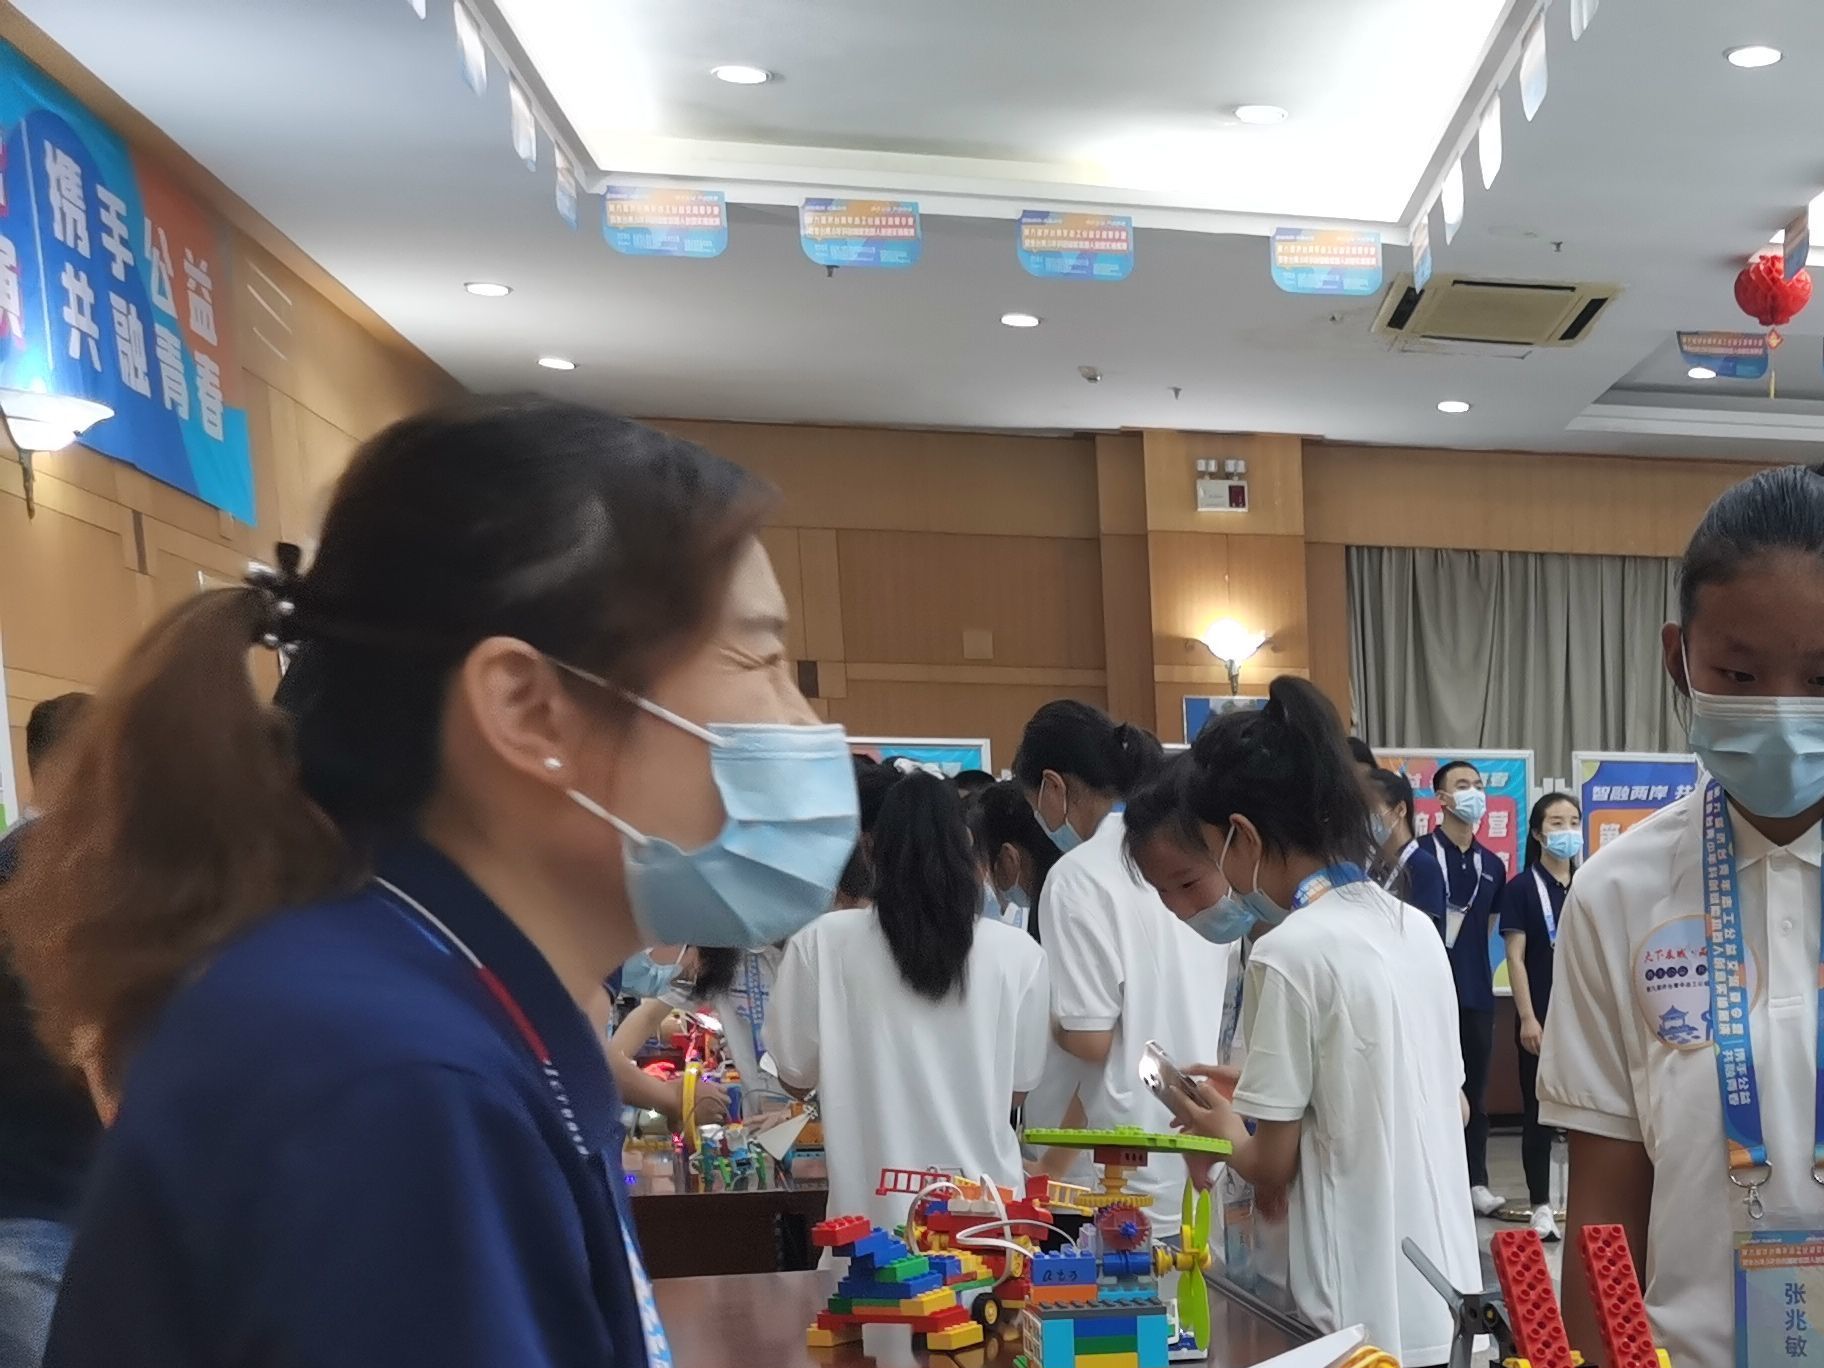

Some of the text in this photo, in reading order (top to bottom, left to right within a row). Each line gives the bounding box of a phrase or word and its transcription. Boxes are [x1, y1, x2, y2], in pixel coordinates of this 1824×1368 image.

[44, 138, 218, 348] 携手公益
[60, 260, 225, 442] 共融青春
[1784, 1282, 1808, 1358] 张兆敏
